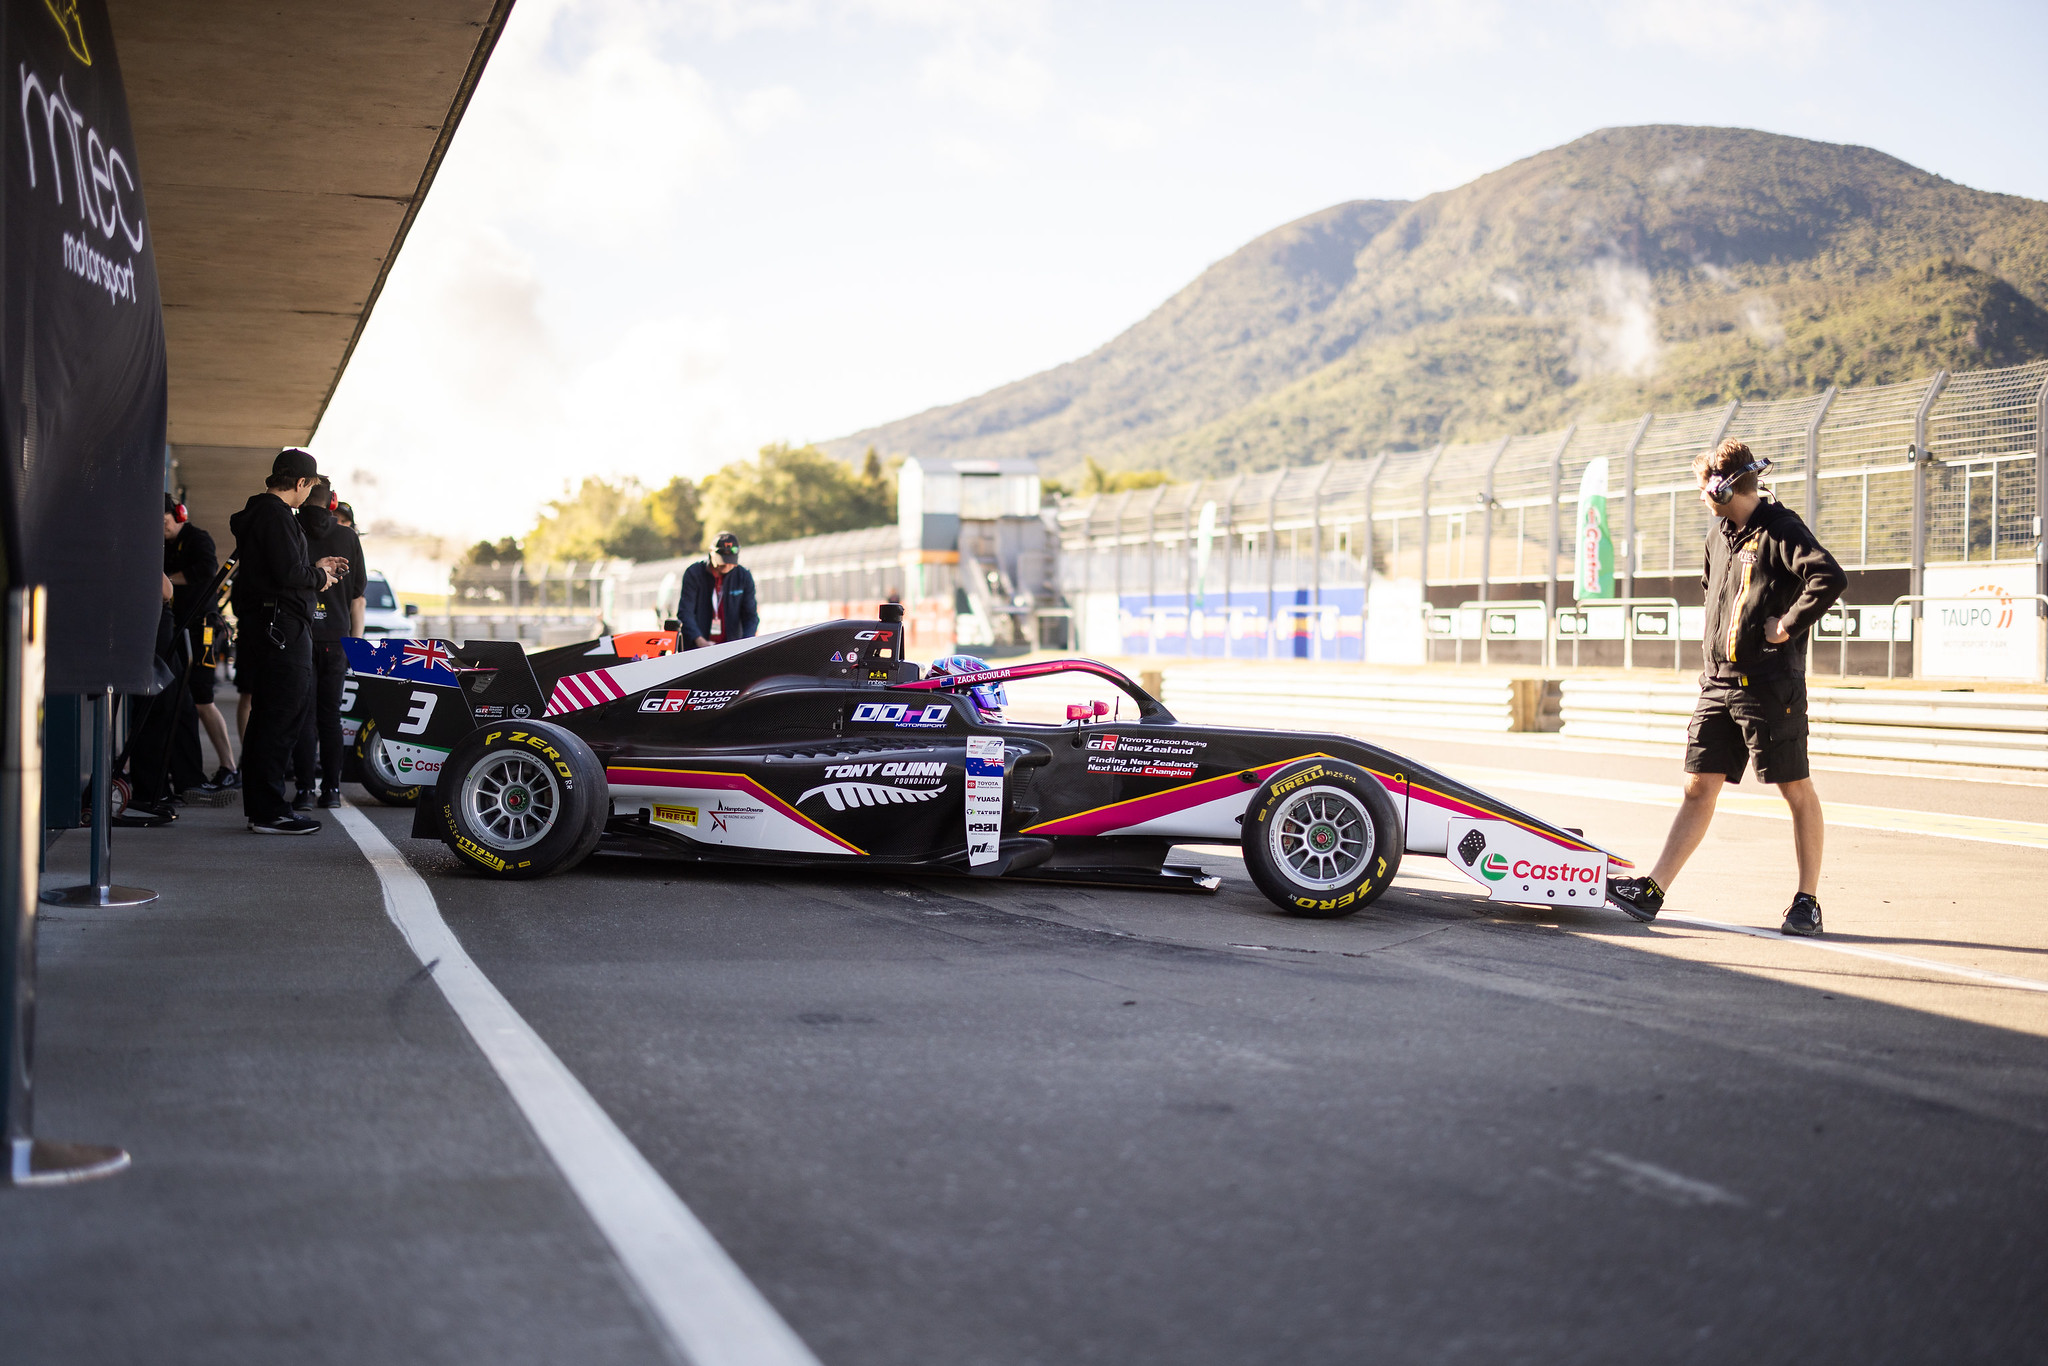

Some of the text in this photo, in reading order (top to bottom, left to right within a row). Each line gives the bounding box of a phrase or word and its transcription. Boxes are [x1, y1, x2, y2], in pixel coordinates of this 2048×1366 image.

[20, 61, 143, 252] mtec
[63, 231, 137, 306] motorsport
[1942, 608, 1992, 627] TAUPO
[646, 638, 673, 646] GR
[854, 630, 894, 642] GR
[957, 669, 1011, 684] ZACK SCOULAR
[397, 690, 439, 735] 3
[641, 698, 684, 711] GR
[684, 703, 726, 712] Racing
[1087, 740, 1116, 750] GR
[1118, 743, 1194, 755] New Zealand
[1120, 736, 1208, 748] TOYOTA GAZOO Racing
[485, 731, 573, 778] P ZERO
[1088, 756, 1199, 769] Finding New Zealand's
[824, 762, 948, 779] TONY QUINN
[1113, 765, 1142, 773] World
[1144, 767, 1192, 777] Champion
[894, 777, 941, 785] FOUNDATION
[1270, 764, 1324, 797] PIRELLI
[656, 806, 696, 823] PIRELLI
[456, 835, 506, 872] PIRELLI
[1512, 859, 1602, 884] Castrol
[1296, 856, 1388, 910] P ZERO
[1647, 878, 1664, 898] mtec
